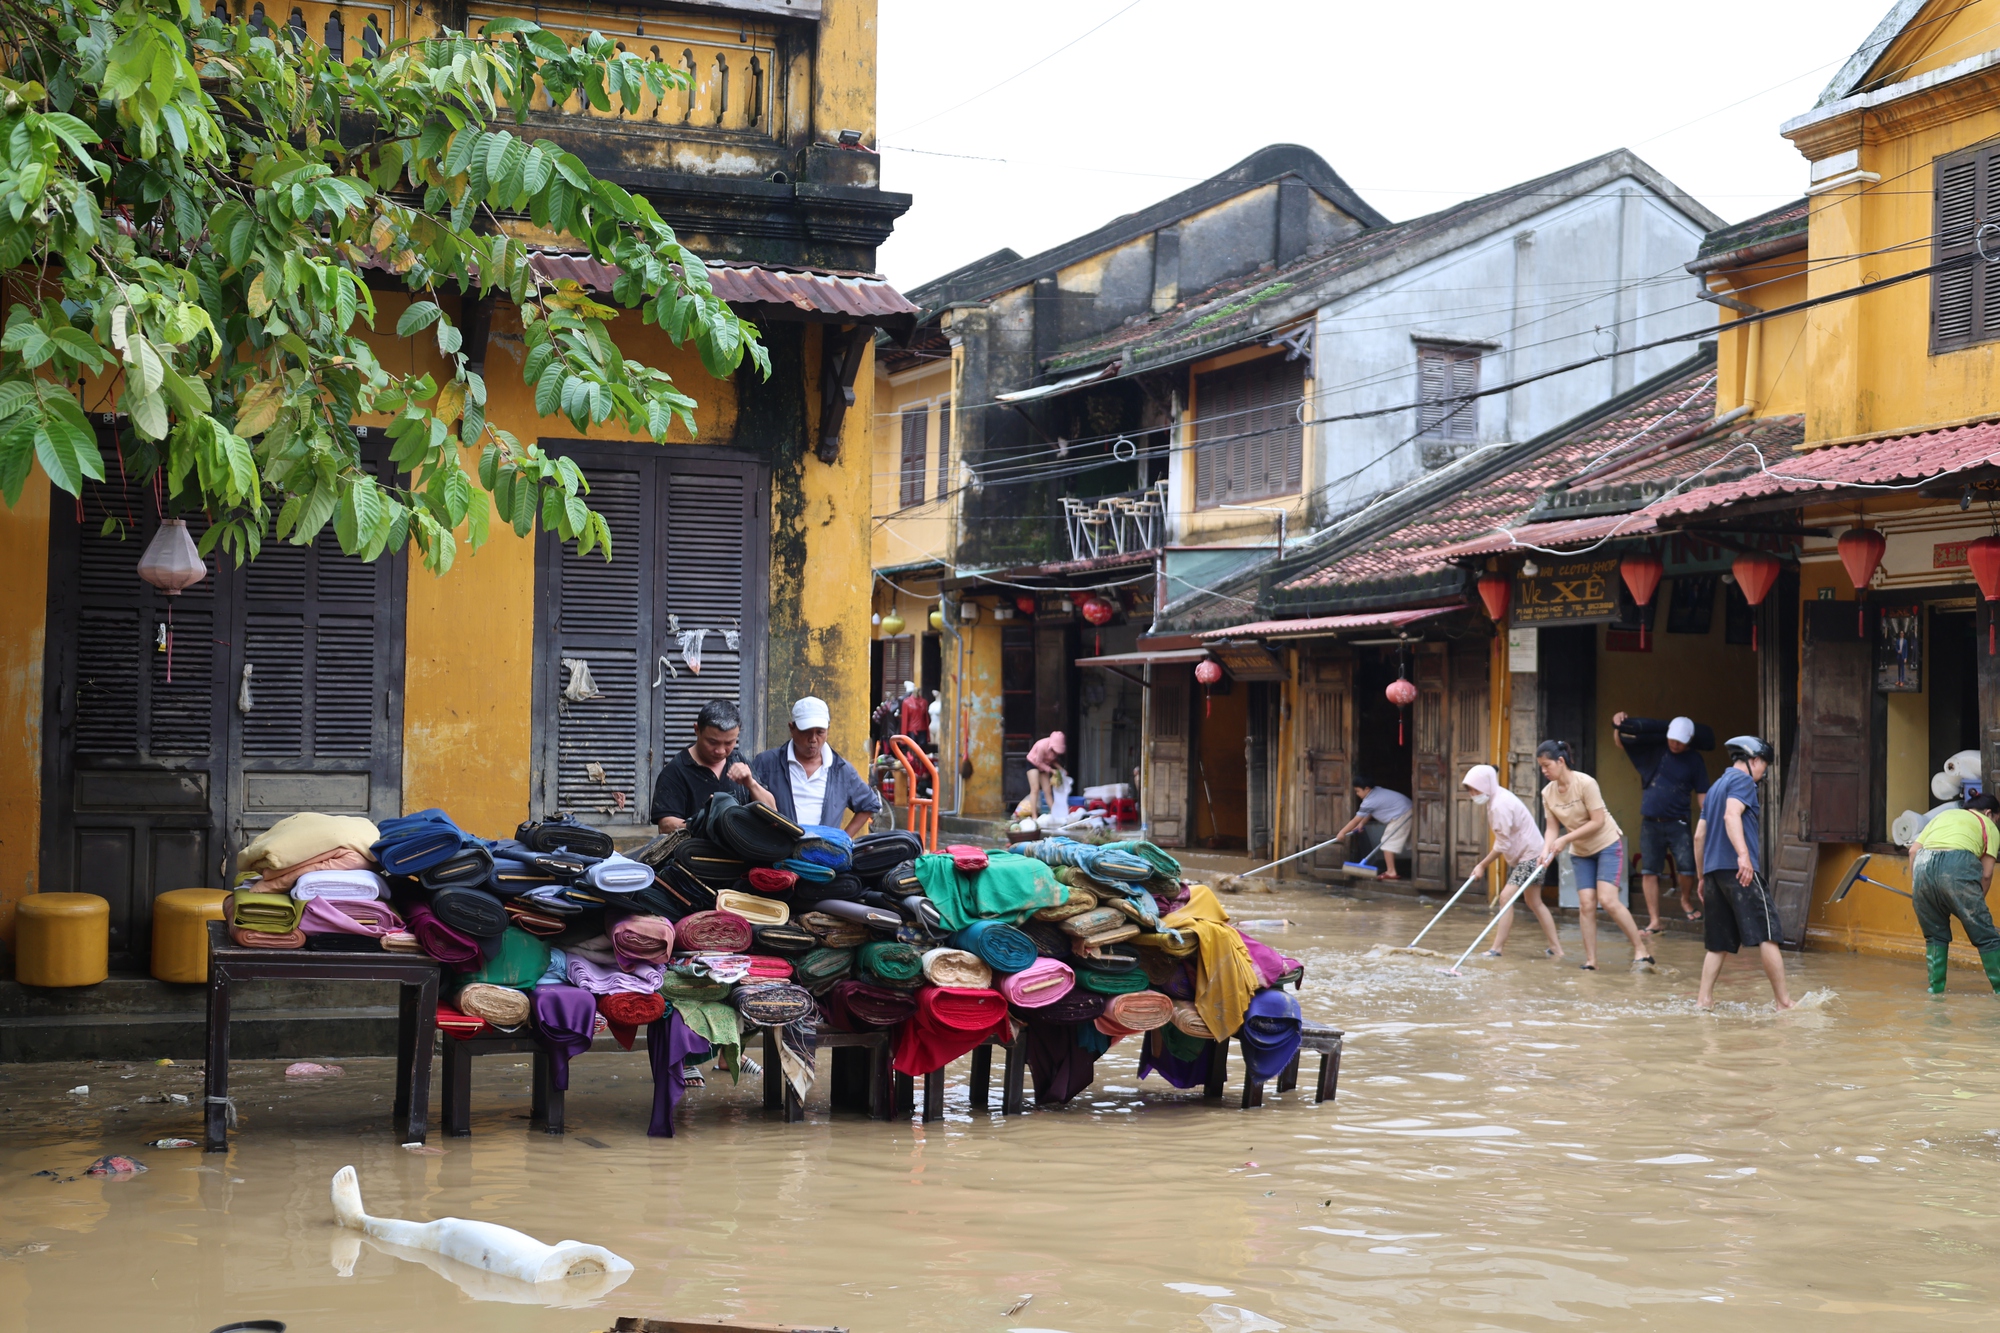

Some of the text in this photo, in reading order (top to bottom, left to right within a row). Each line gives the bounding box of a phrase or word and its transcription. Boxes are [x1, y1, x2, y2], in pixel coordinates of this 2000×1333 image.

[1559, 563, 1589, 576] CLOTH
[1592, 559, 1617, 572] SHOP
[1550, 573, 1606, 604] XÊ
[1819, 590, 1832, 600] 71
